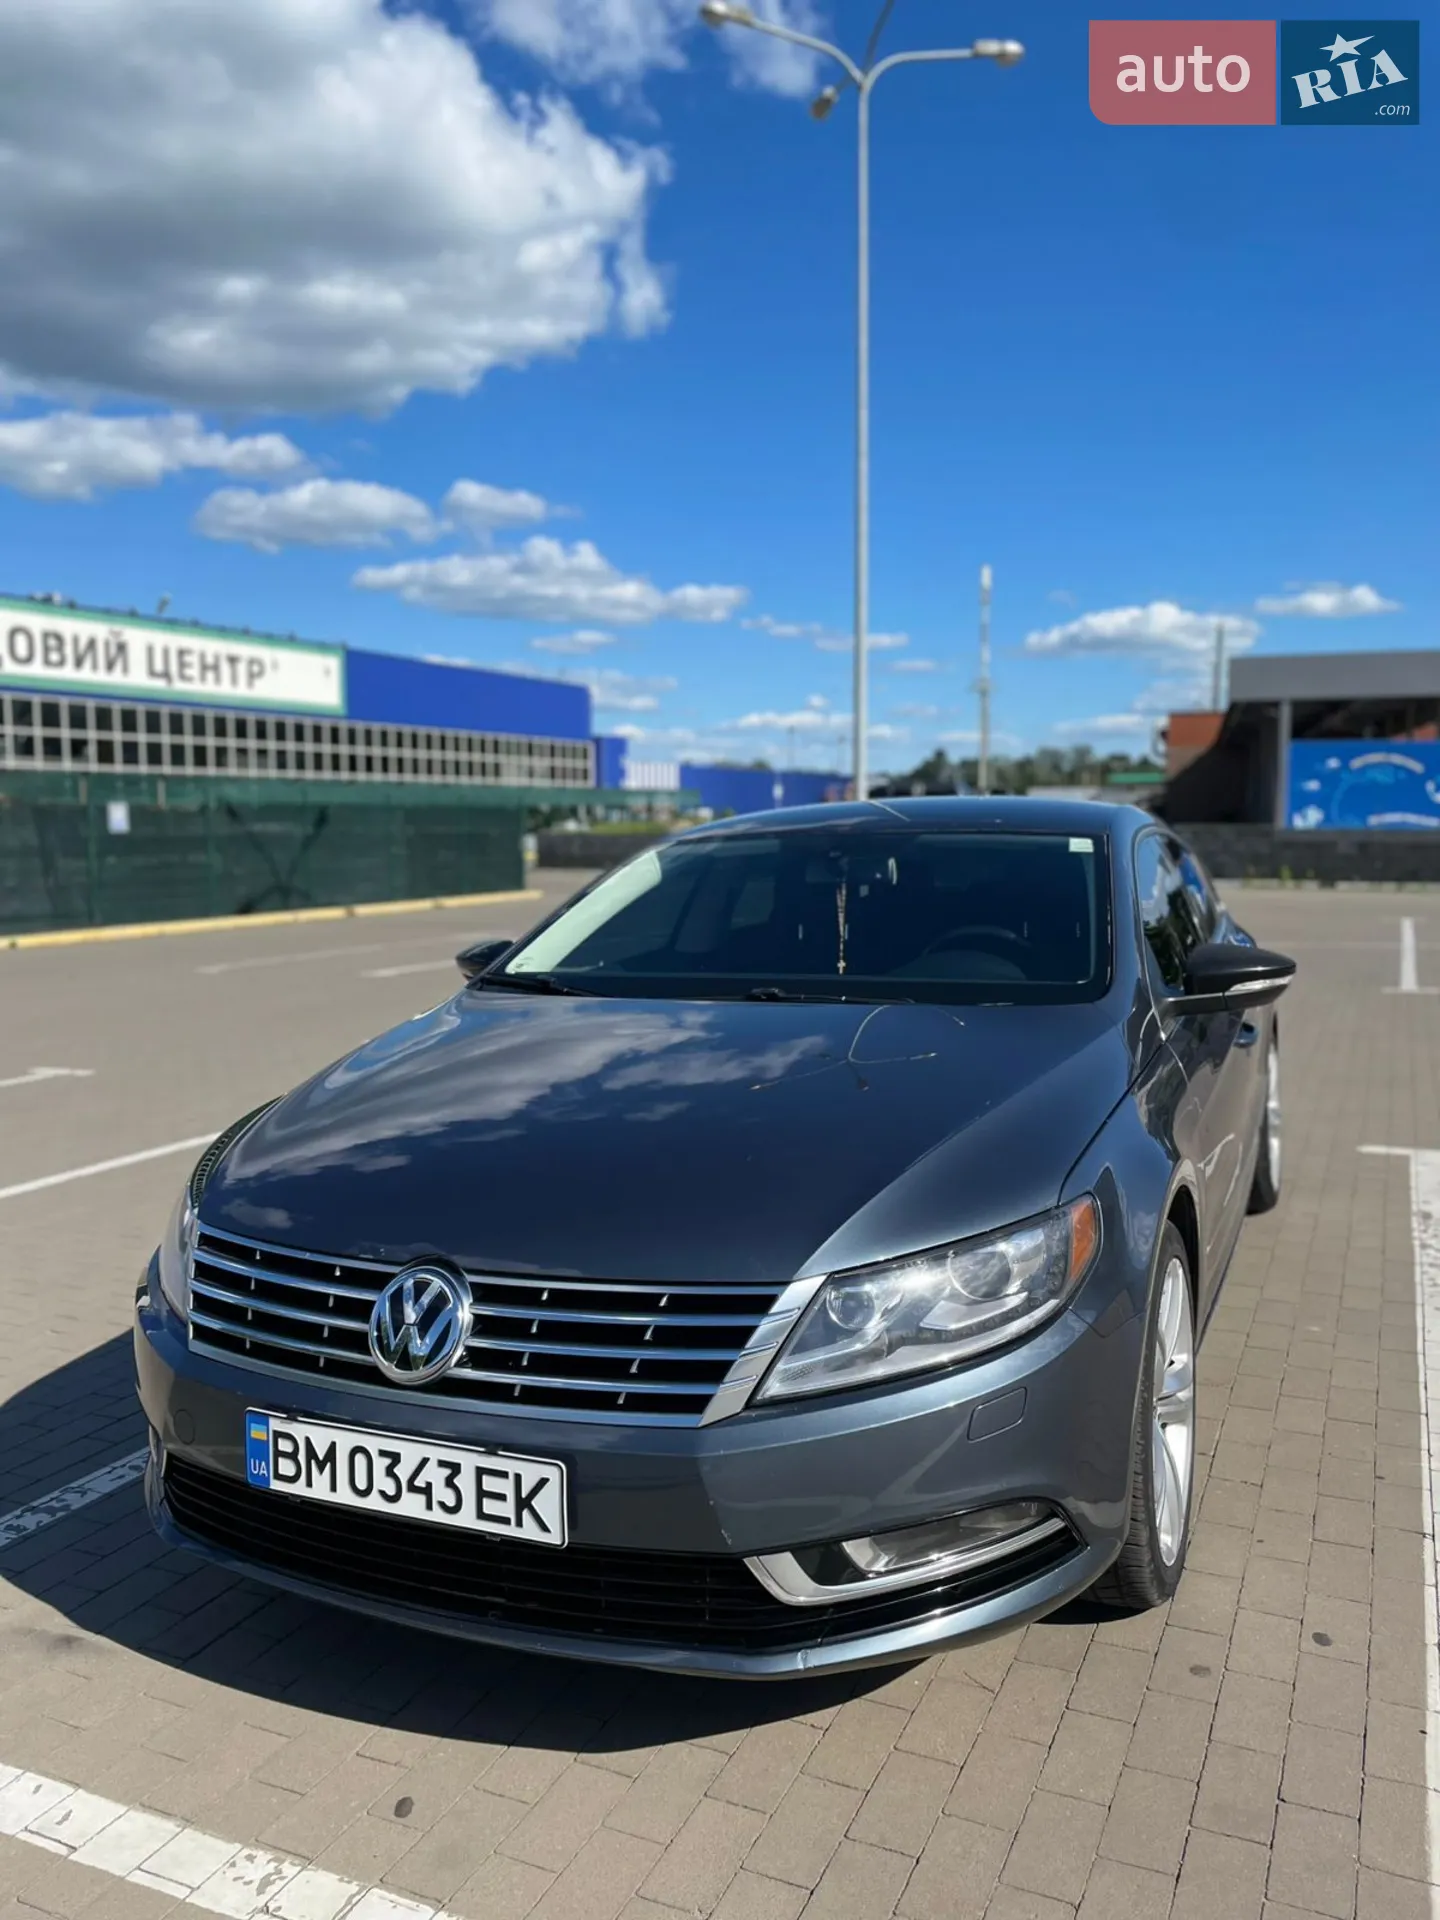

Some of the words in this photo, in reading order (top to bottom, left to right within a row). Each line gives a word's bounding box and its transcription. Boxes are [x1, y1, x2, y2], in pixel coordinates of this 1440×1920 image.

[0, 624, 129, 678] ОВИЙ
[145, 643, 267, 689] ЦЕНТР
[250, 1458, 268, 1477] UA
